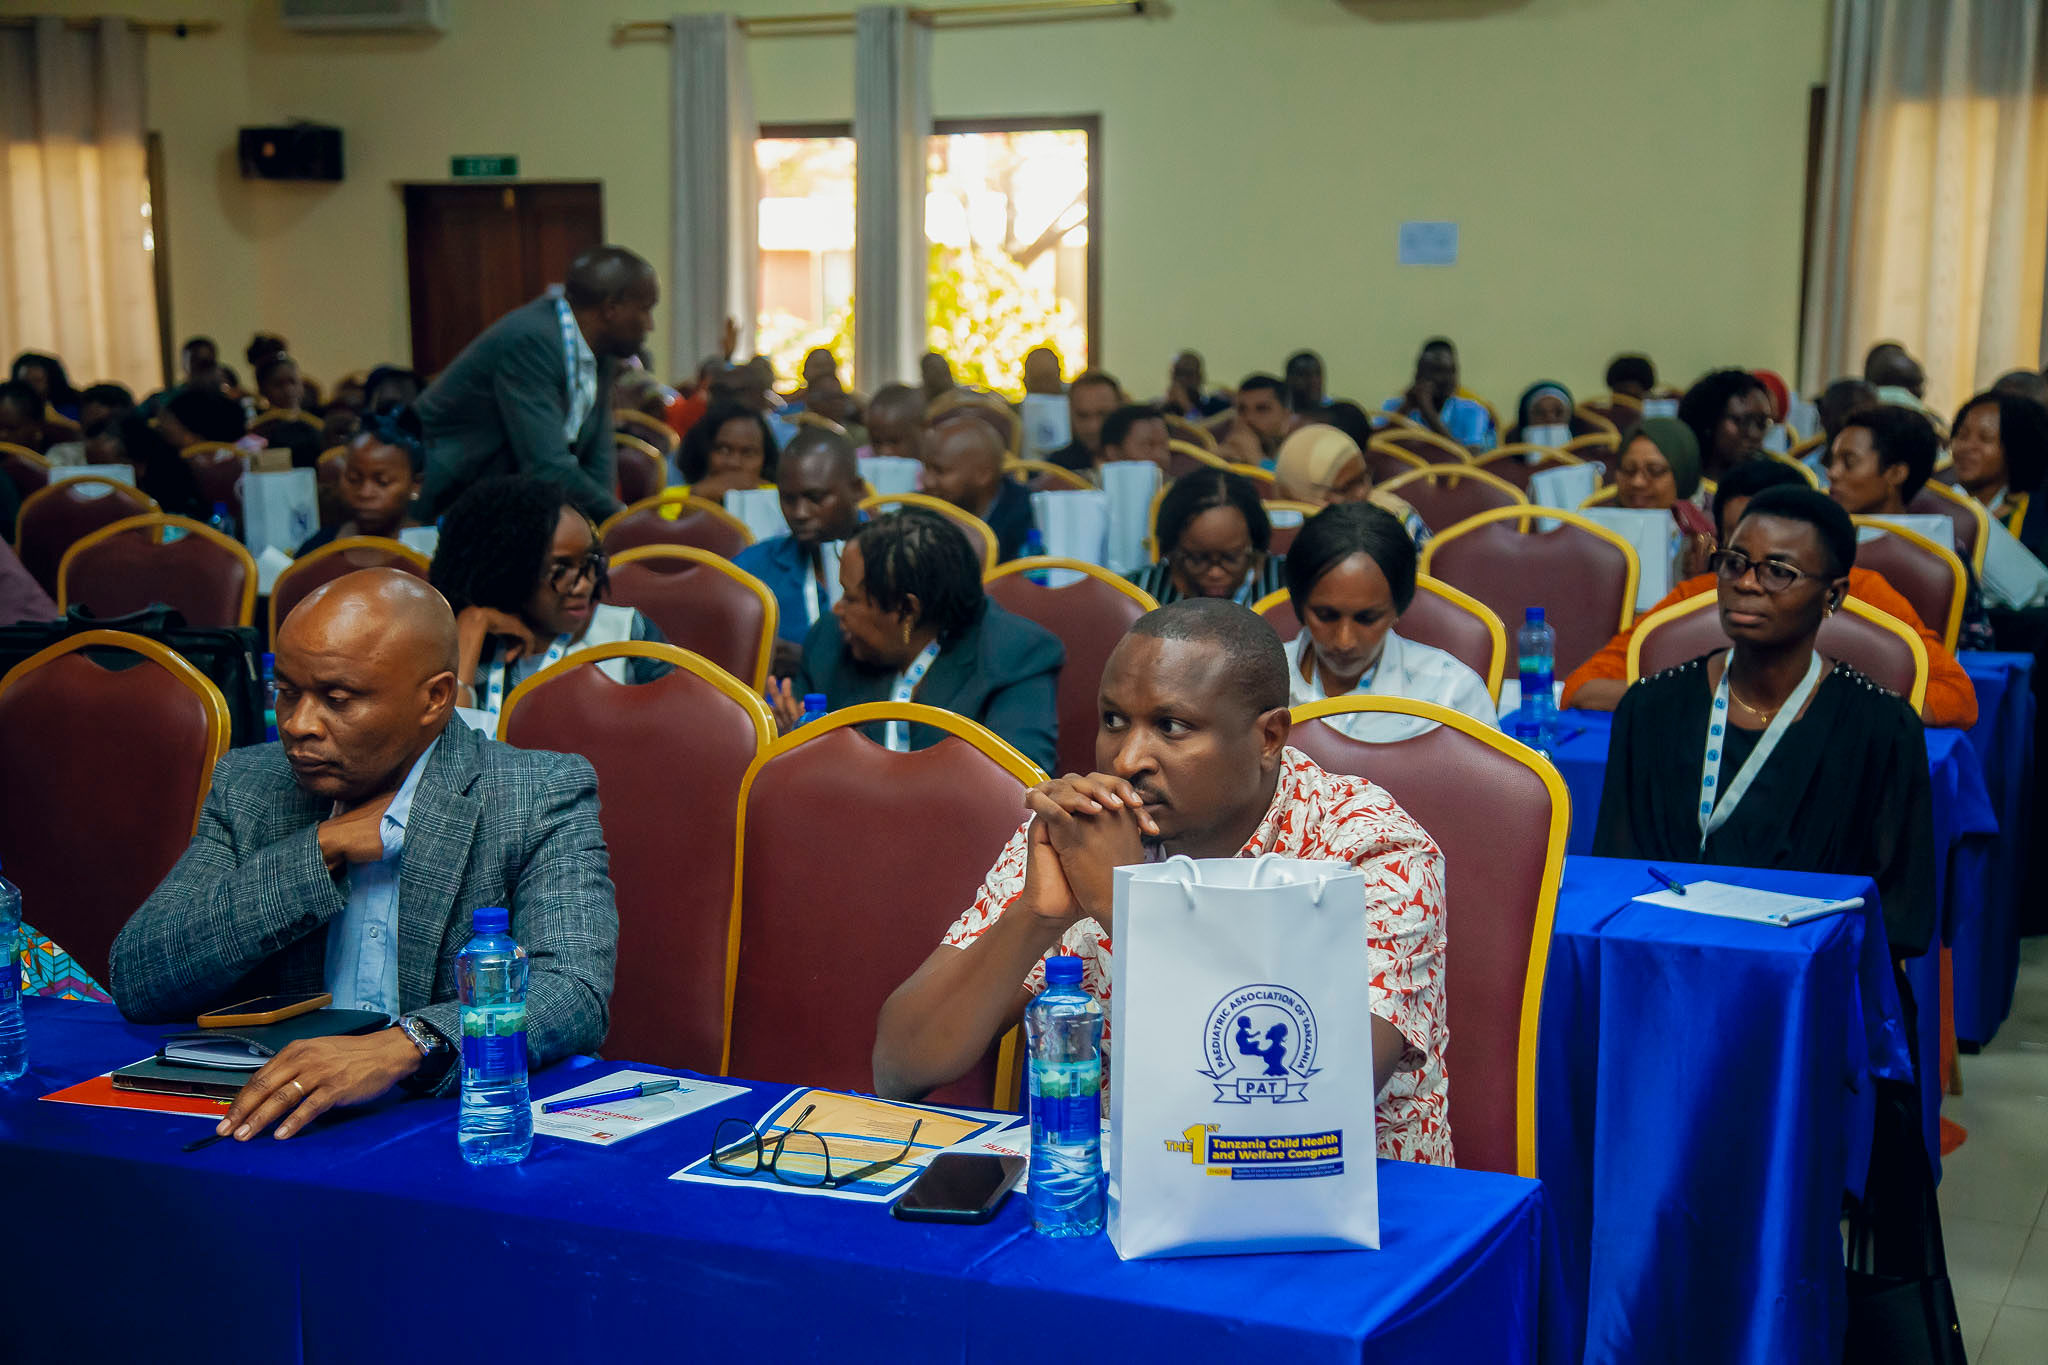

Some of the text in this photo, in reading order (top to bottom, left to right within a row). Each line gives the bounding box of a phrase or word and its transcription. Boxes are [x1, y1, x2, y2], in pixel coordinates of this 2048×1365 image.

[1212, 991, 1313, 1069] PAEDIATRIC ASSOCIATION OF TANZANIA
[1246, 1082, 1278, 1094] PAT
[1164, 1139, 1193, 1153] THE
[1212, 1133, 1339, 1150] Tanzania Child Health
[1212, 1146, 1340, 1160] and Welfare Congress
